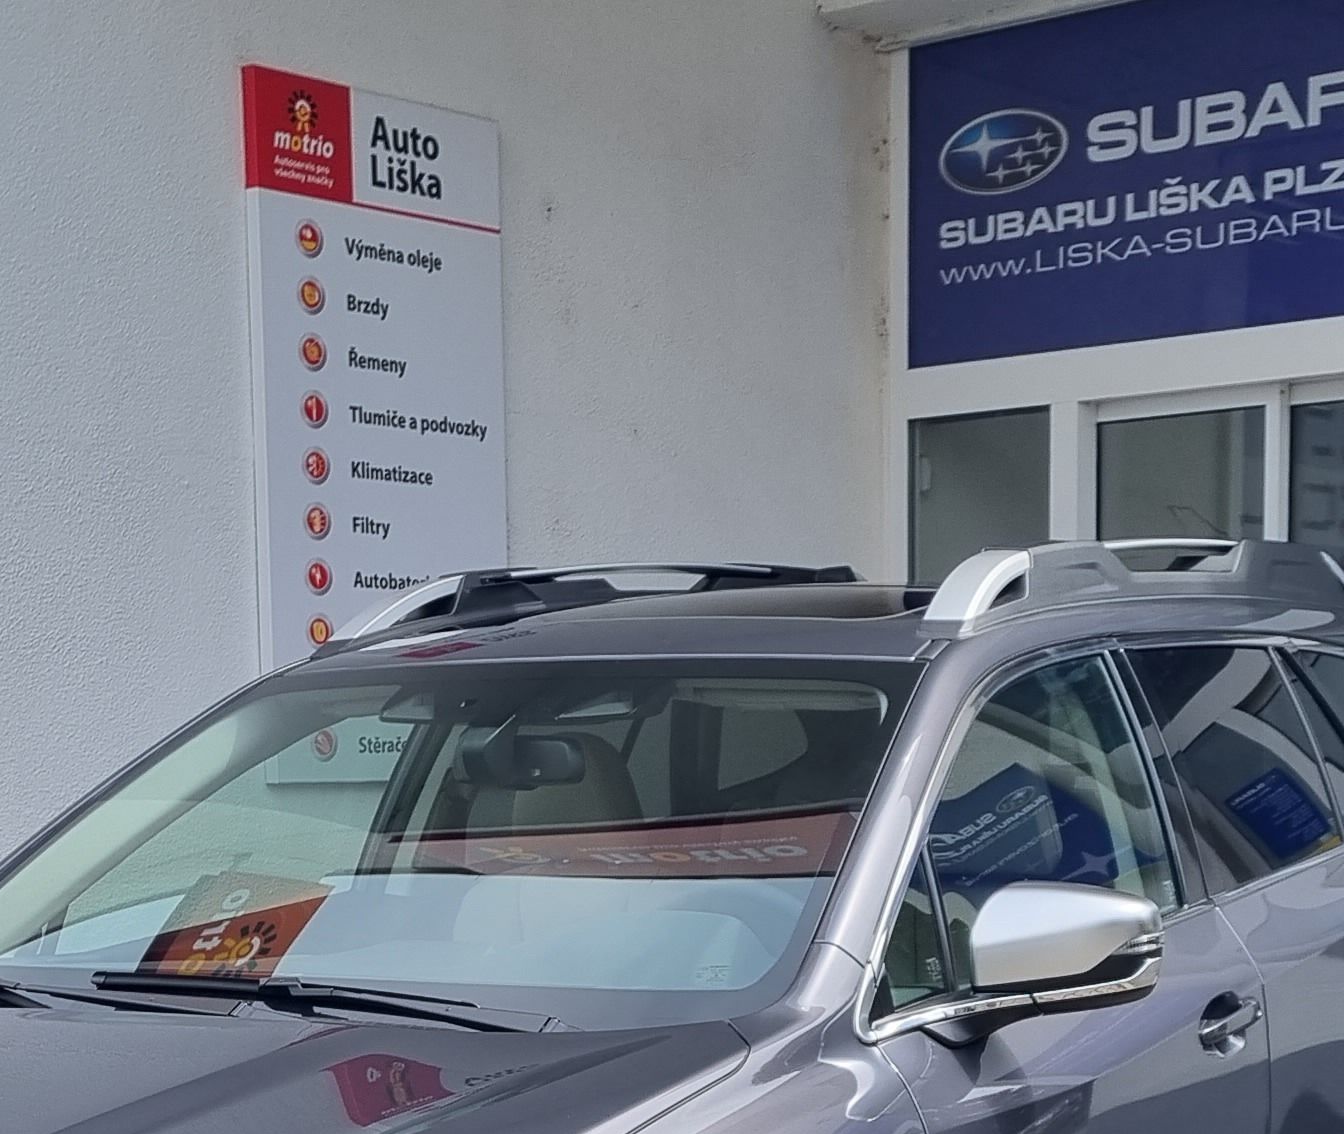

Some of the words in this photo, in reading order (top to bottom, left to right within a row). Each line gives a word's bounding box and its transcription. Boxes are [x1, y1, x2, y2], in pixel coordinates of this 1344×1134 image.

[273, 130, 334, 159] motrio
[370, 116, 440, 161] Auto
[370, 154, 443, 200] Liška
[939, 195, 1116, 250] SUBARU
[1125, 176, 1256, 221] LIŠKA
[344, 236, 404, 265] Výměna
[407, 247, 442, 274] oleje
[347, 294, 389, 320] Brzdy
[348, 347, 407, 378] Řemeny
[349, 406, 406, 429] Tlumiče
[408, 416, 417, 430] a
[420, 413, 488, 442] podvozky
[351, 461, 434, 486] Klimatizace
[352, 516, 391, 540] Filtry
